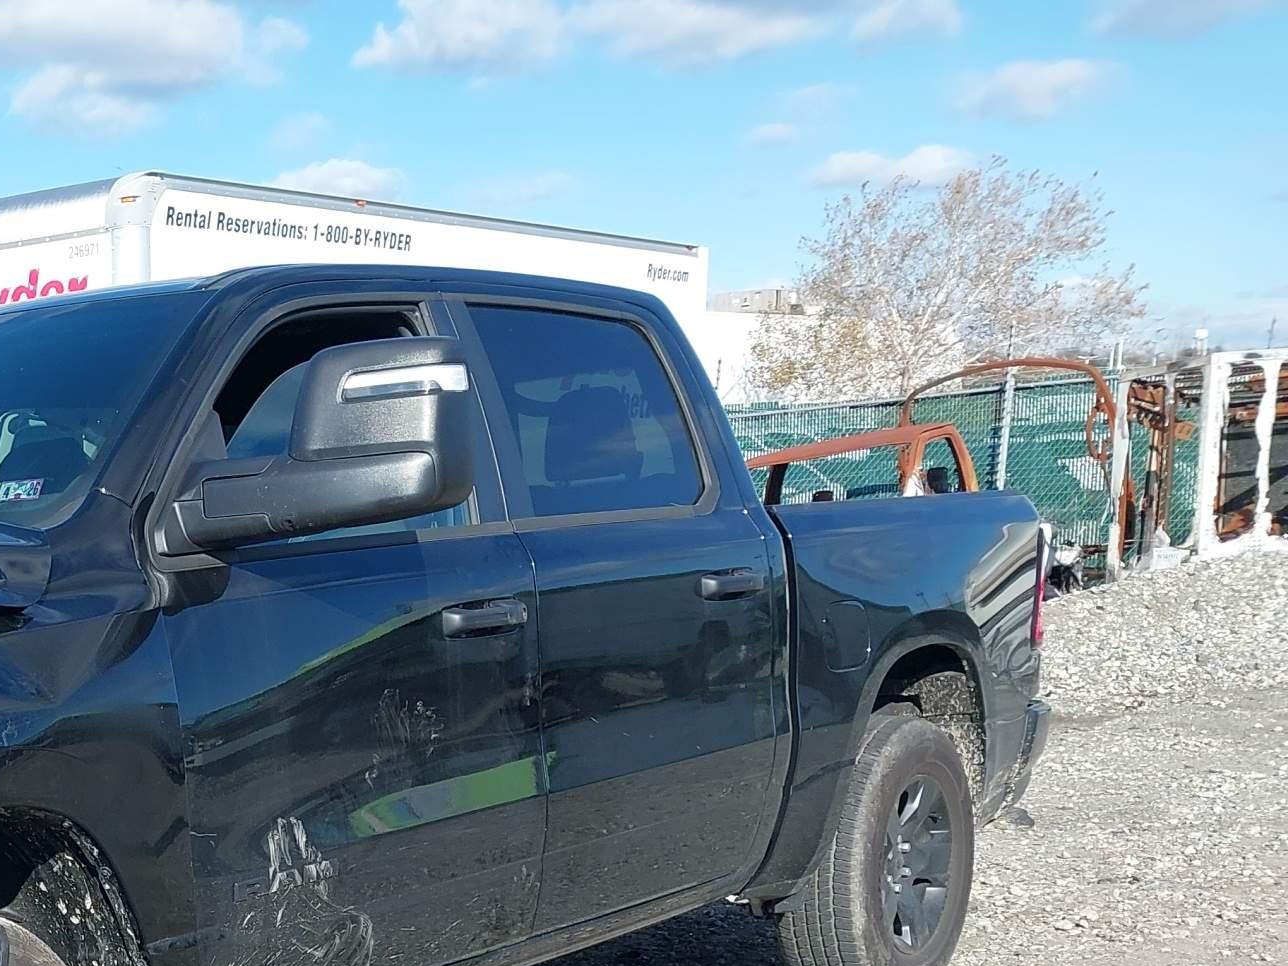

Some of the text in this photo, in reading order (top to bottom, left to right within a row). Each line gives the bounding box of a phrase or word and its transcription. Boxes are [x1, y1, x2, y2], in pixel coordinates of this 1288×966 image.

[166, 206, 412, 251] Rental Reservations: 1-800-BY-RYDER
[68, 242, 101, 259] 246971
[647, 264, 689, 282] Ryder.com
